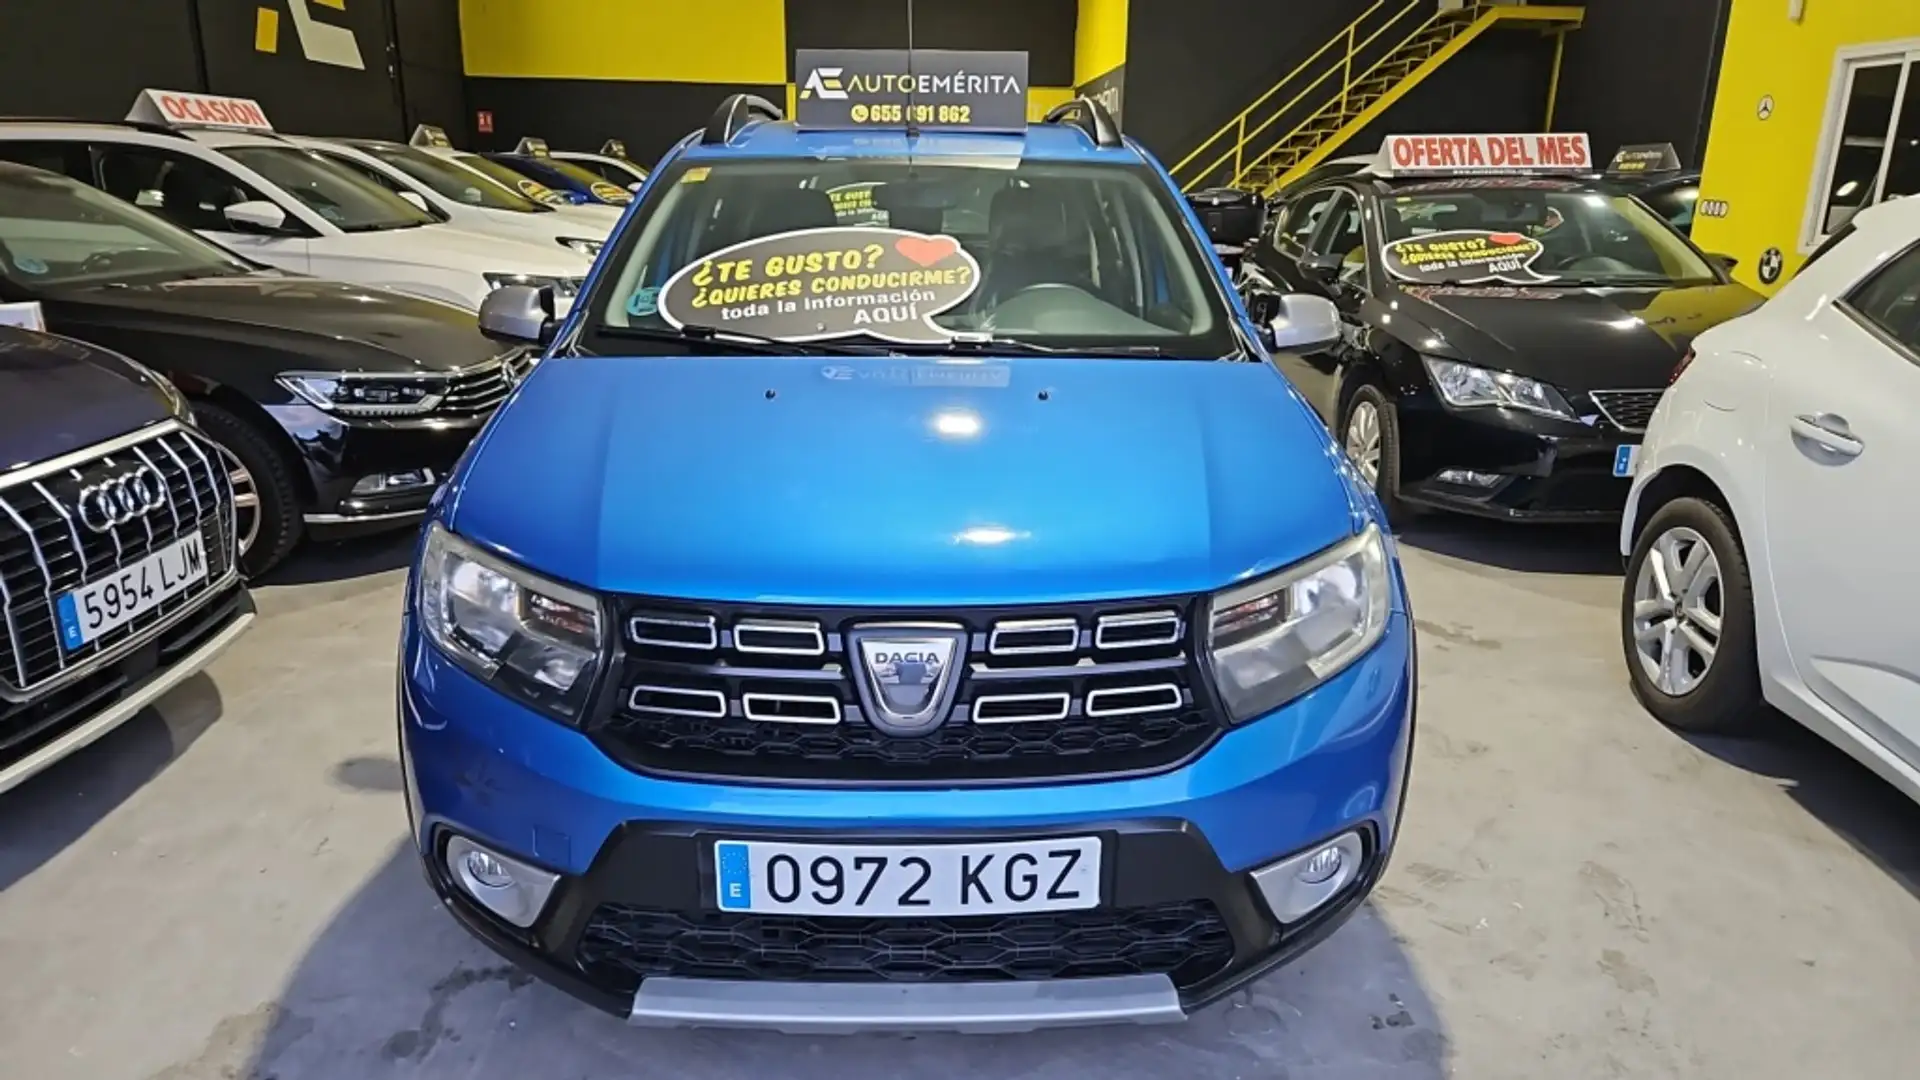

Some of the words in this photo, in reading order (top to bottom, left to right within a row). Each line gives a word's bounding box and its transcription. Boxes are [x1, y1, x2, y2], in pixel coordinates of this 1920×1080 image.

[847, 70, 1021, 94] AUTOEMÉRITA
[870, 104, 901, 123] 655
[938, 104, 971, 123] 862
[1393, 136, 1485, 166] OFERTA
[1487, 136, 1534, 166] DEL
[1536, 135, 1586, 166] MES
[692, 259, 753, 286] ¿TE
[765, 244, 884, 277] GUSTO?
[1488, 258, 1522, 273] AQUÍ
[691, 280, 802, 308] ¿QUIERES
[811, 266, 971, 294] CONDUCIRME?
[721, 303, 770, 320] toda
[777, 300, 797, 314] la
[853, 303, 919, 325] AQUÍ
[84, 566, 154, 629] 5954
[158, 538, 202, 591] LJM
[67, 626, 78, 638] E
[875, 652, 940, 664] DACIA
[766, 853, 932, 907] 0972
[960, 849, 1082, 905] KGZ
[729, 883, 742, 897] E
